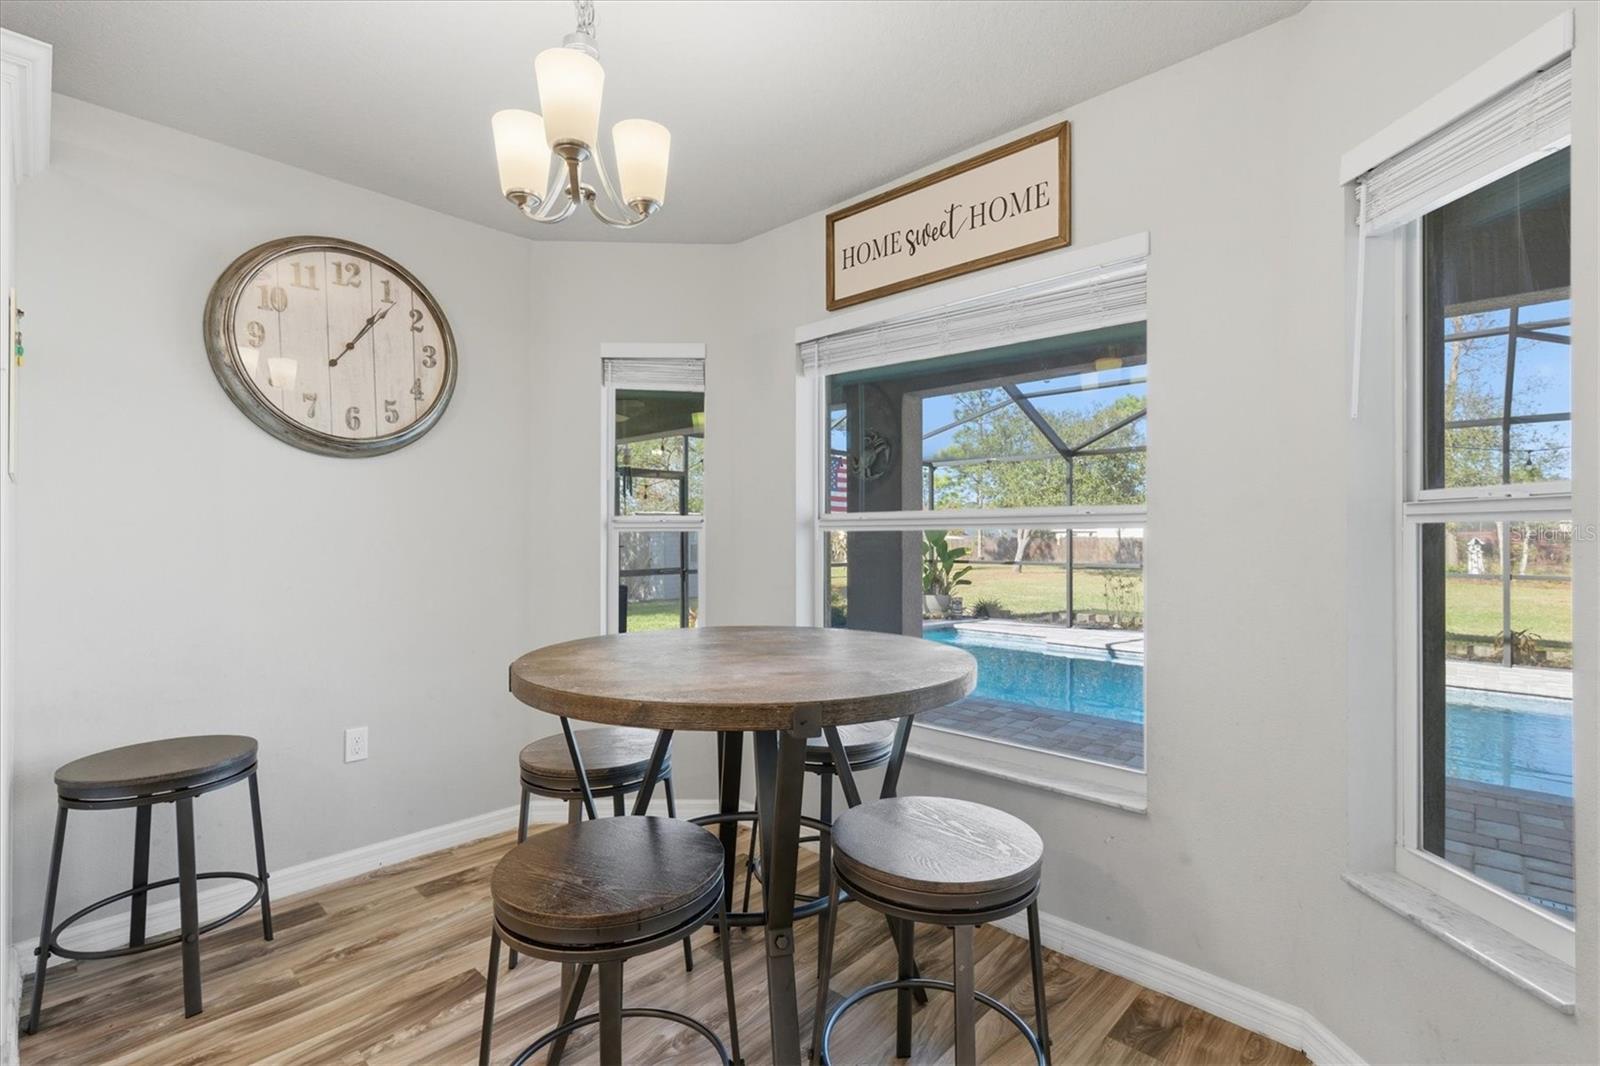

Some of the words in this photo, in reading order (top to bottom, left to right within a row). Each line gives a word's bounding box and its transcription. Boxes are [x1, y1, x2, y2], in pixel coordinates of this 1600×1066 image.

[842, 230, 902, 270] HOME
[905, 203, 968, 256] sweet
[969, 181, 1050, 230] HOME
[290, 262, 319, 291] 11
[331, 261, 361, 288] 12
[257, 284, 288, 313] 10
[380, 279, 394, 304] 1
[409, 309, 424, 333] 2
[247, 321, 265, 348] 9
[422, 345, 437, 368] 3
[410, 378, 424, 401] 4
[302, 393, 317, 418] 7
[345, 406, 361, 430] 6
[384, 400, 400, 423] 5
